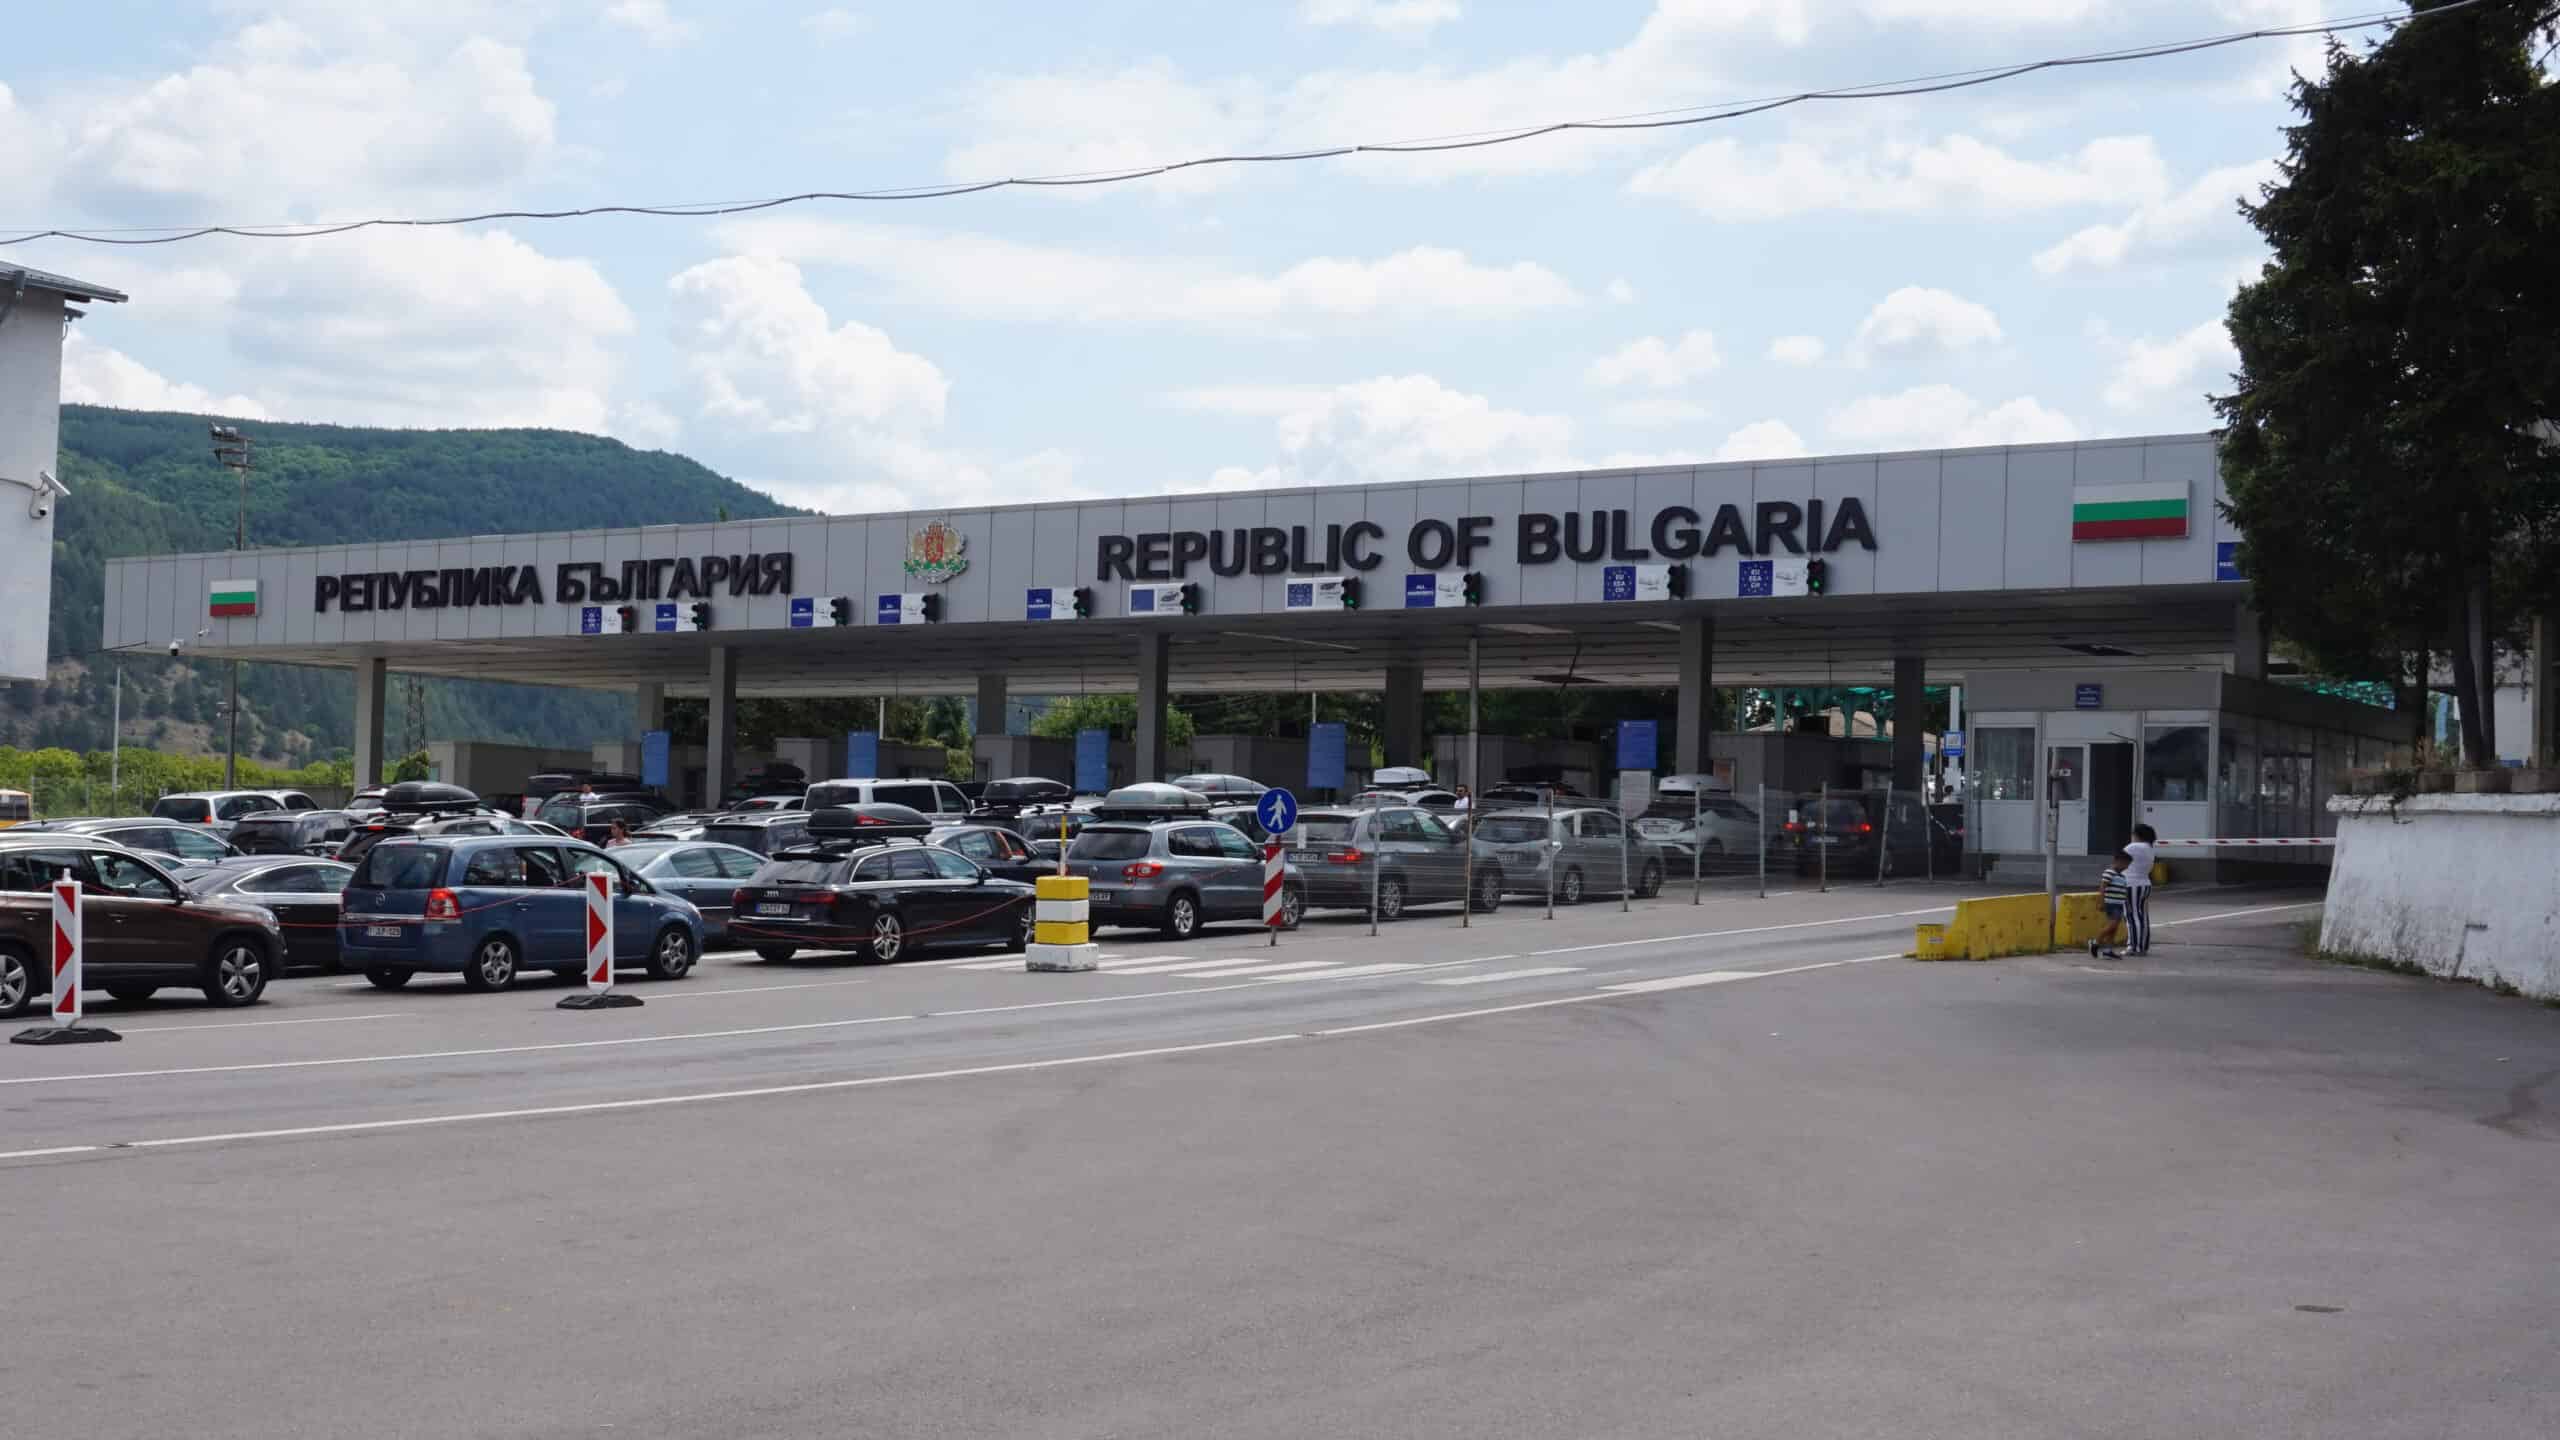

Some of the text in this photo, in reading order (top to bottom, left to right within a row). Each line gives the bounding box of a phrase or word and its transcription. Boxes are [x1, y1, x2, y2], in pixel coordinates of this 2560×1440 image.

[1097, 497, 1877, 581] REPUBLIC OF BULGARIA
[315, 552, 792, 613] РЕПУБЛИКА БЪЛГАРИЯ
